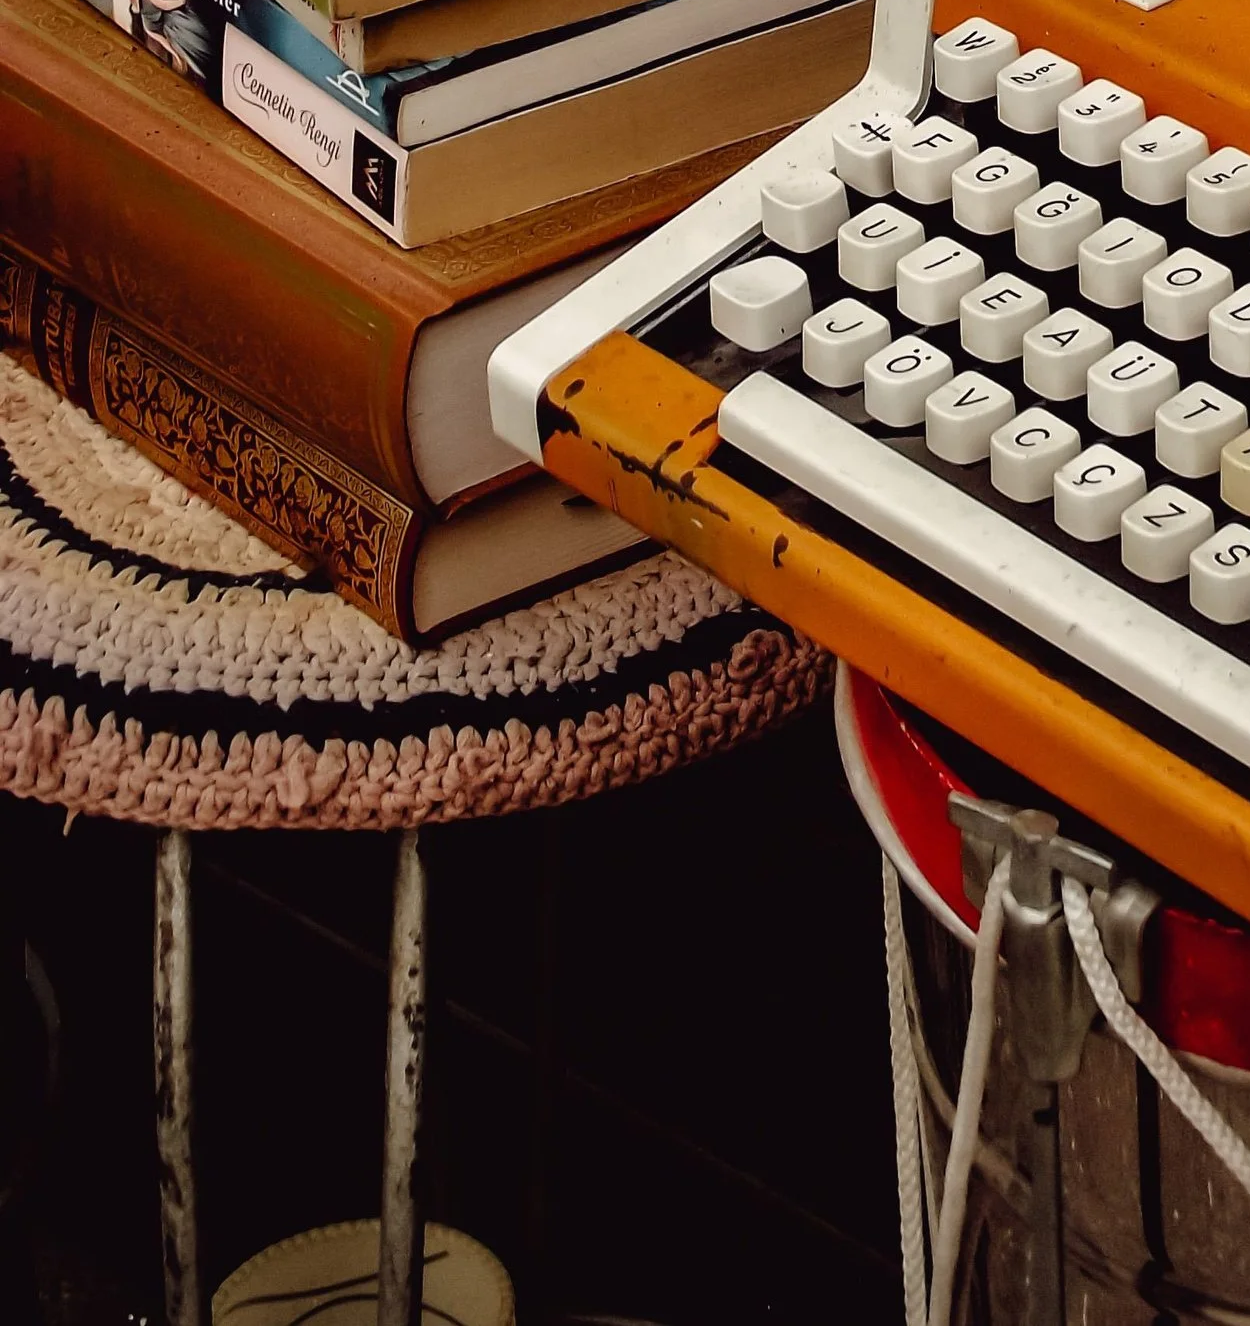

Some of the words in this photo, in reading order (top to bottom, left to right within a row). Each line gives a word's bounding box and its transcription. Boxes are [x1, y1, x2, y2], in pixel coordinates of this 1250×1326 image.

[954, 30, 996, 52] W
[233, 62, 298, 125] Cennetin
[299, 109, 343, 168] Rengi
[1075, 104, 1102, 116] 3
[912, 133, 953, 148] F
[1138, 142, 1157, 153] 4
[975, 164, 1009, 182] G
[1203, 172, 1231, 185] 5
[860, 219, 898, 239] U
[1166, 267, 1202, 287] O
[980, 288, 1022, 310] E
[825, 321, 864, 333] J
[1042, 328, 1080, 348] A
[886, 348, 932, 374] Ö
[1110, 355, 1149, 381] Ü
[953, 387, 990, 407] V
[1183, 398, 1221, 420] T
[1014, 428, 1050, 447] C
[1072, 464, 1116, 486] Ç
[1142, 502, 1187, 528] Z
